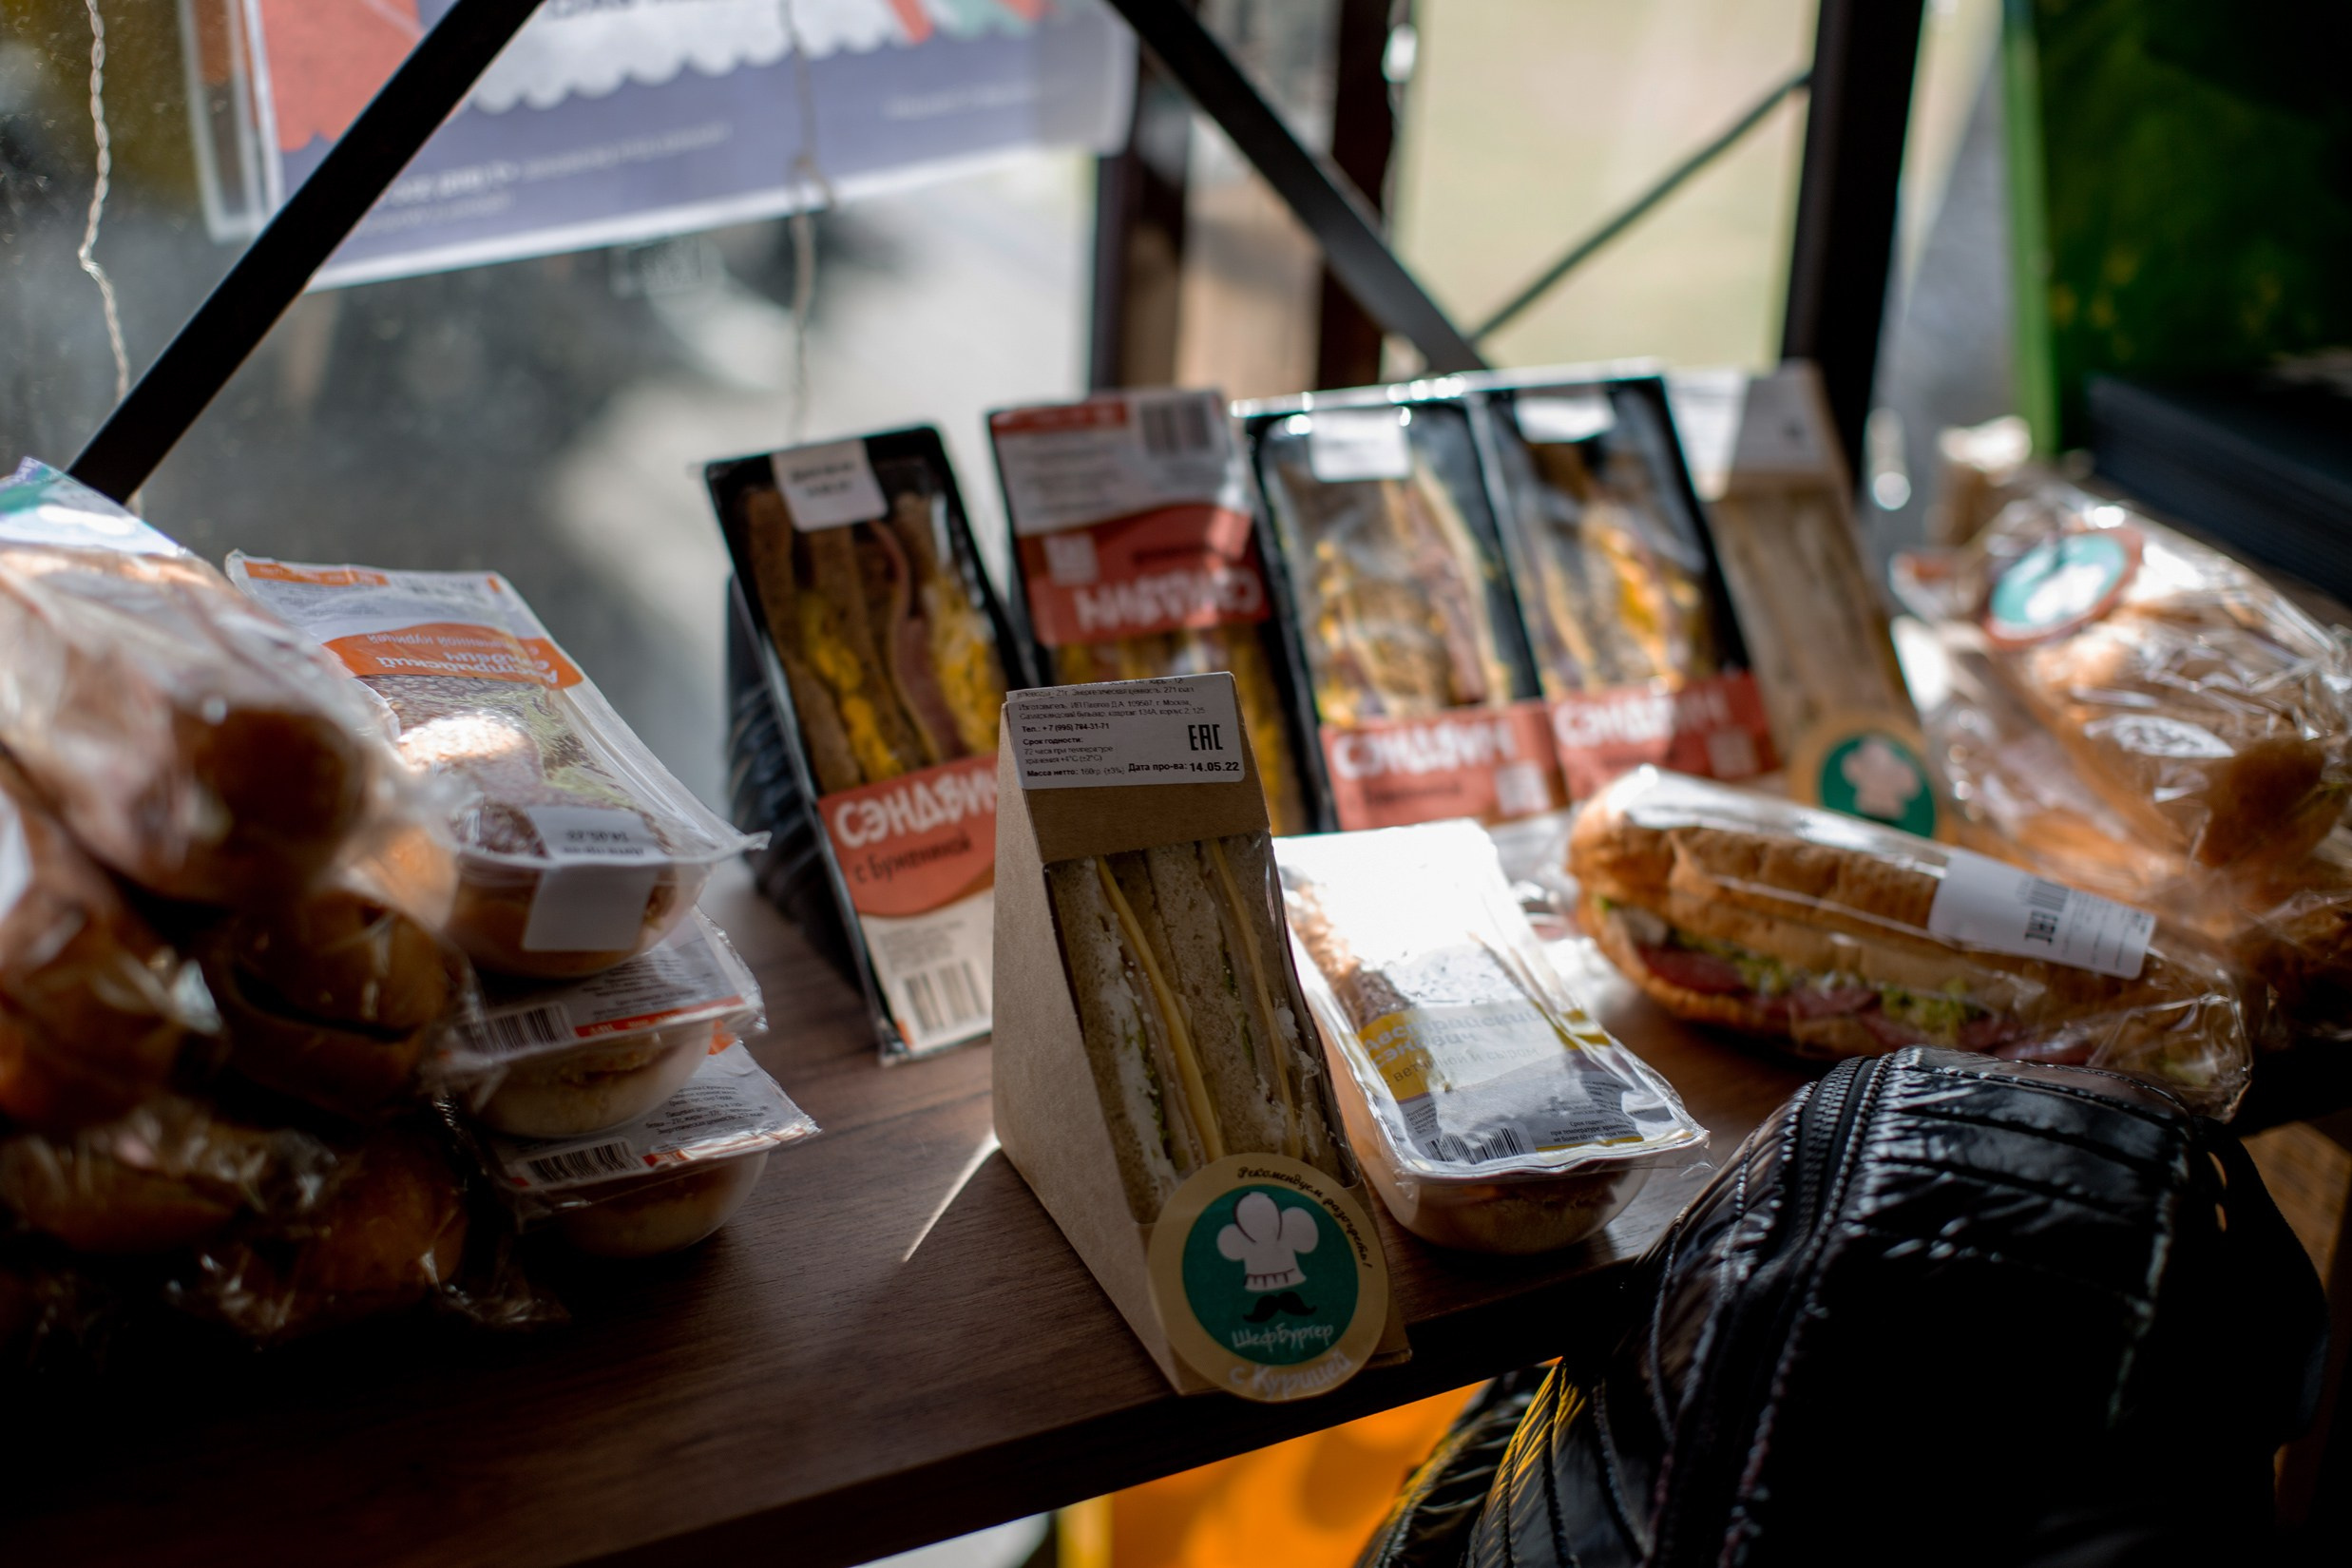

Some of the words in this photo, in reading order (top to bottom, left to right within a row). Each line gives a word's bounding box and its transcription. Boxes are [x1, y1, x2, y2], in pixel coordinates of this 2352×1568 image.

[1074, 722, 1110, 731] 784-31-71
[1023, 737, 1042, 746] Срок
[1044, 736, 1084, 745] годности:
[1026, 769, 1052, 777] Масса
[1053, 768, 1080, 776] нетто:
[1128, 763, 1151, 774] Дата
[1153, 762, 1188, 772] про-ва:
[1189, 761, 1240, 773] 14.05.22
[832, 766, 998, 850] СЭНДВИ
[1392, 1054, 1468, 1082] ветчиной
[1237, 1166, 1324, 1198] Рекомендуем
